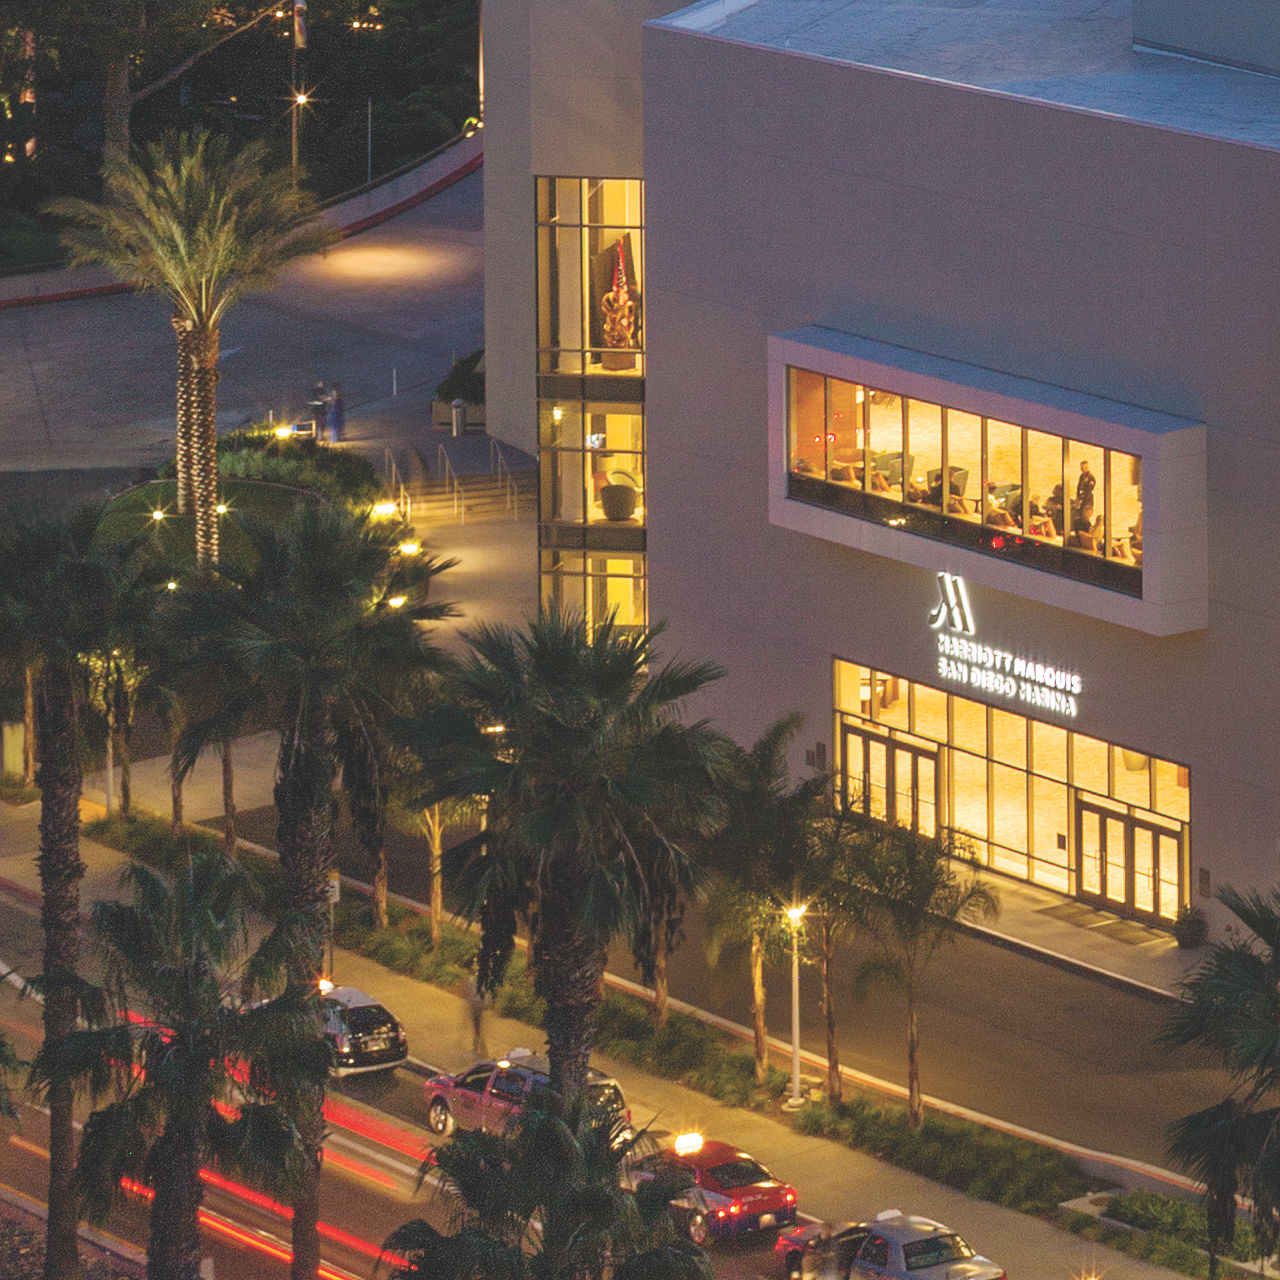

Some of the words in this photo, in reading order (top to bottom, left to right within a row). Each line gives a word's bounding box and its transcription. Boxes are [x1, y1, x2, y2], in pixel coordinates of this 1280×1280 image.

[938, 633, 1013, 673] MARRIOTT
[1014, 657, 1082, 695] MARQUIS
[938, 657, 968, 684] SAN
[970, 666, 1017, 698] DIEGO
[1019, 680, 1078, 718] MARINA
